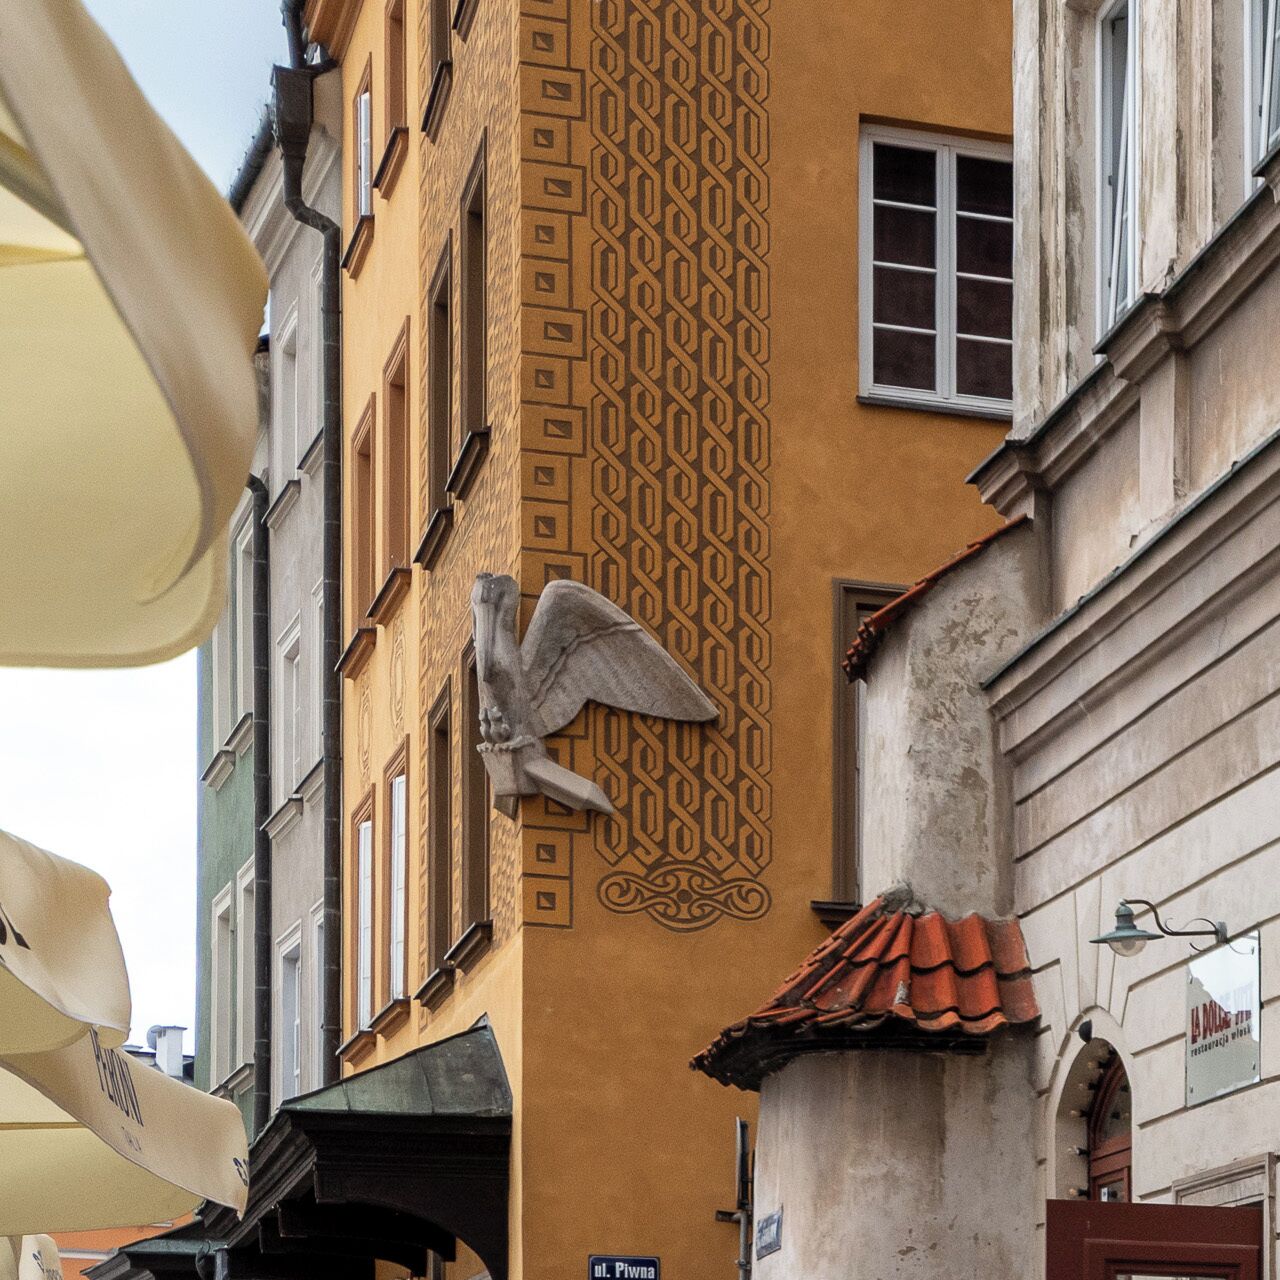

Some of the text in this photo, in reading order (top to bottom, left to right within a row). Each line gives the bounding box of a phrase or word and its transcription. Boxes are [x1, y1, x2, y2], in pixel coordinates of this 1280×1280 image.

[1191, 1005, 1201, 1045] LA
[1191, 1033, 1228, 1057] restauracja
[594, 1261, 655, 1279] ul. Piwna
